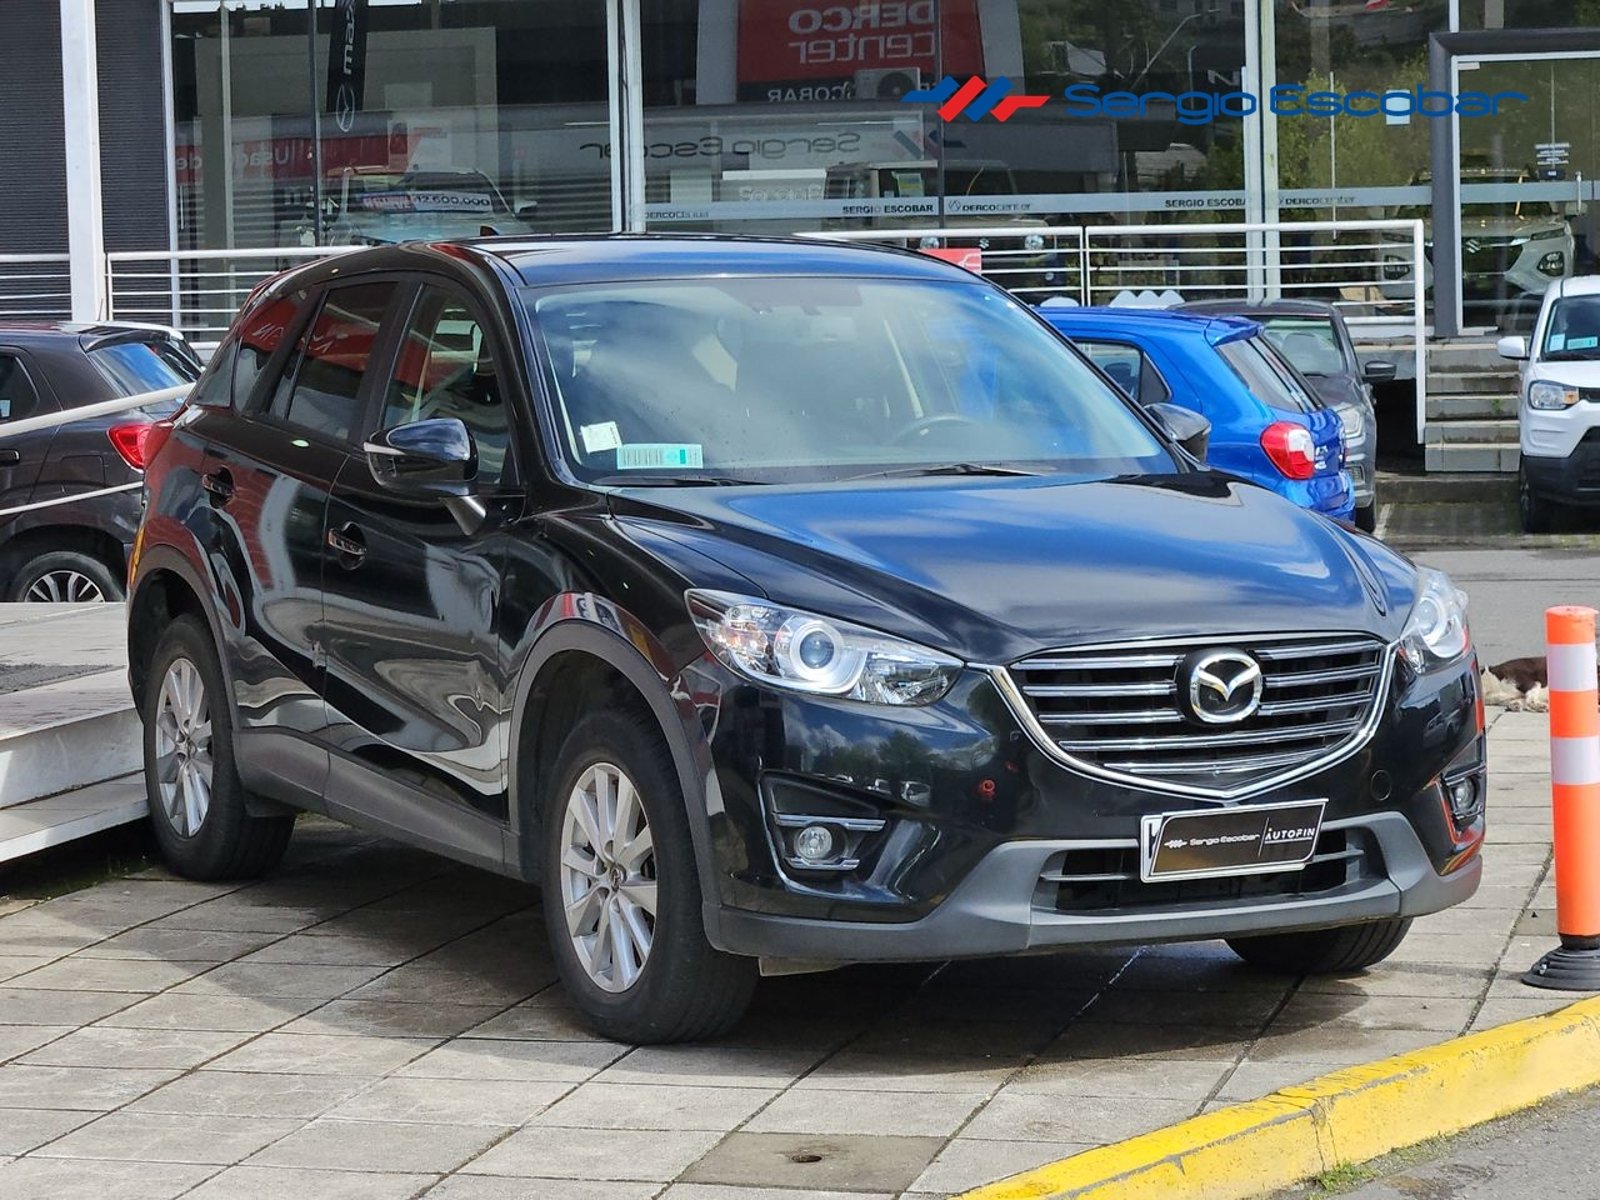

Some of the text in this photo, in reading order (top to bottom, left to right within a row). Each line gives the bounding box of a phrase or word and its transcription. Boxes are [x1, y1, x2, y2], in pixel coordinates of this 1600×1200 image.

[1164, 198, 1245, 208] SERGIO ESCOBA
[842, 204, 934, 214] SERGIO ESCOBAR
[1220, 833, 1261, 844] Escobar
[1265, 827, 1316, 841] AUTOFIN
